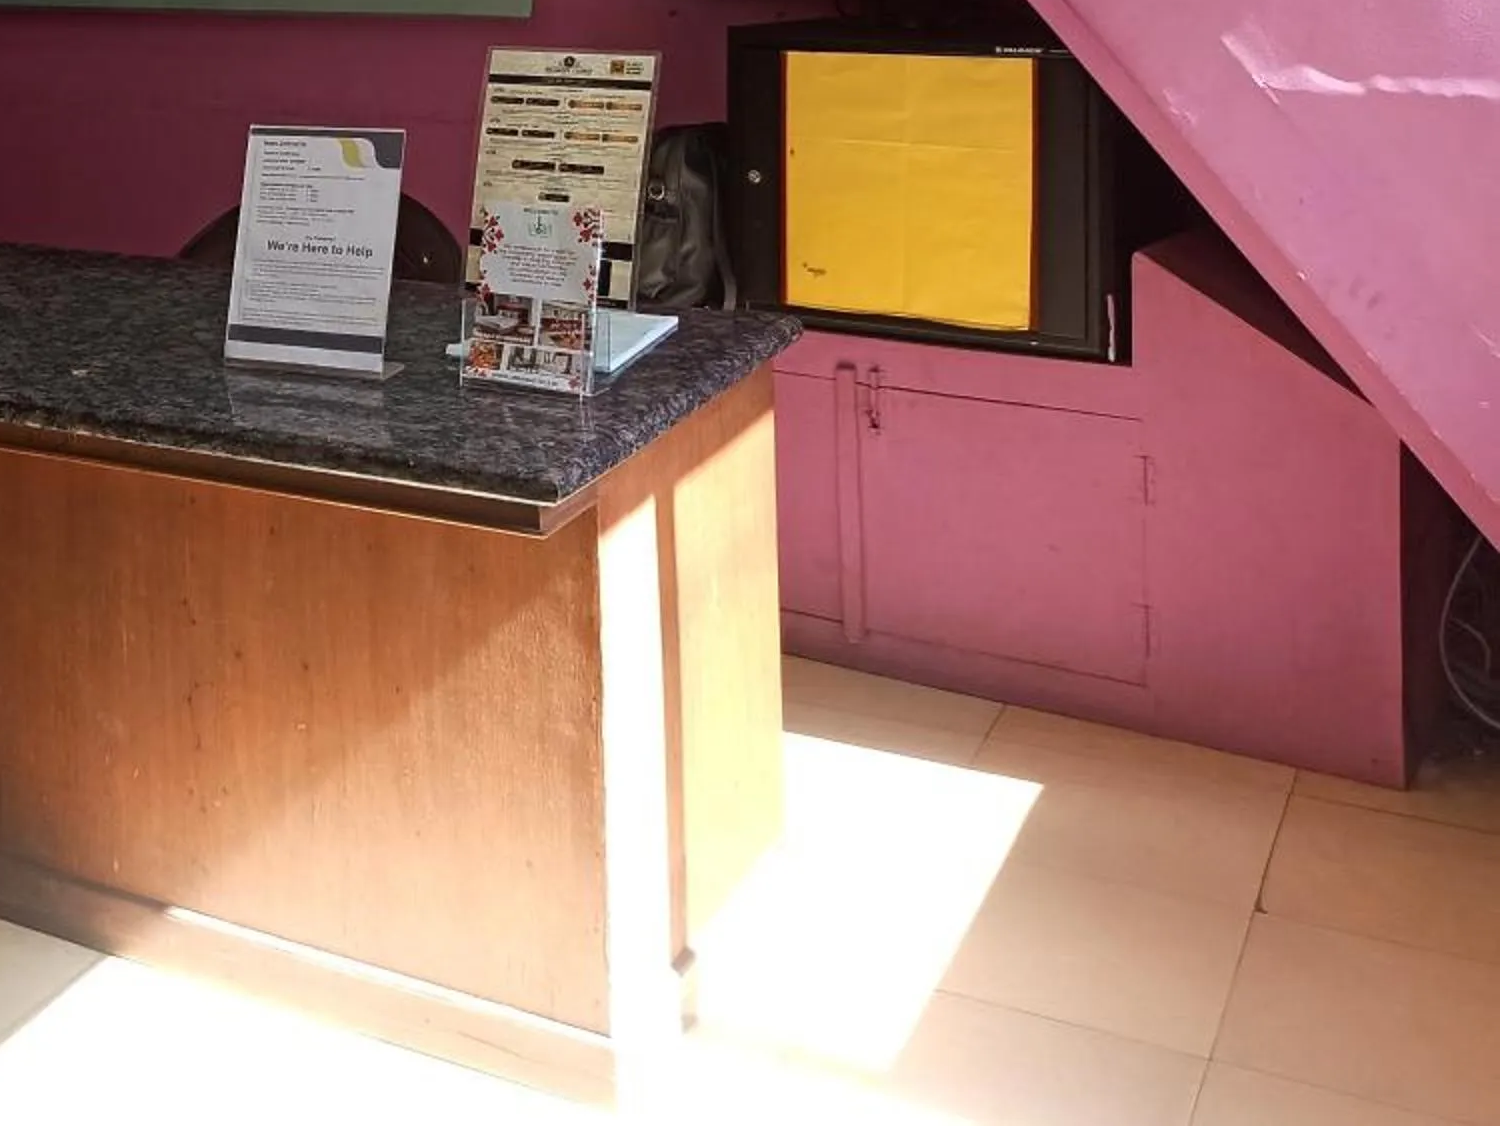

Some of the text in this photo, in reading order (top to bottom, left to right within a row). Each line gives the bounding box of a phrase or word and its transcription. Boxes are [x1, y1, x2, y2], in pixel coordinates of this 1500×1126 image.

[267, 238, 300, 253] We're
[302, 241, 330, 256] Here
[331, 243, 343, 256] to
[346, 242, 374, 259] Help
